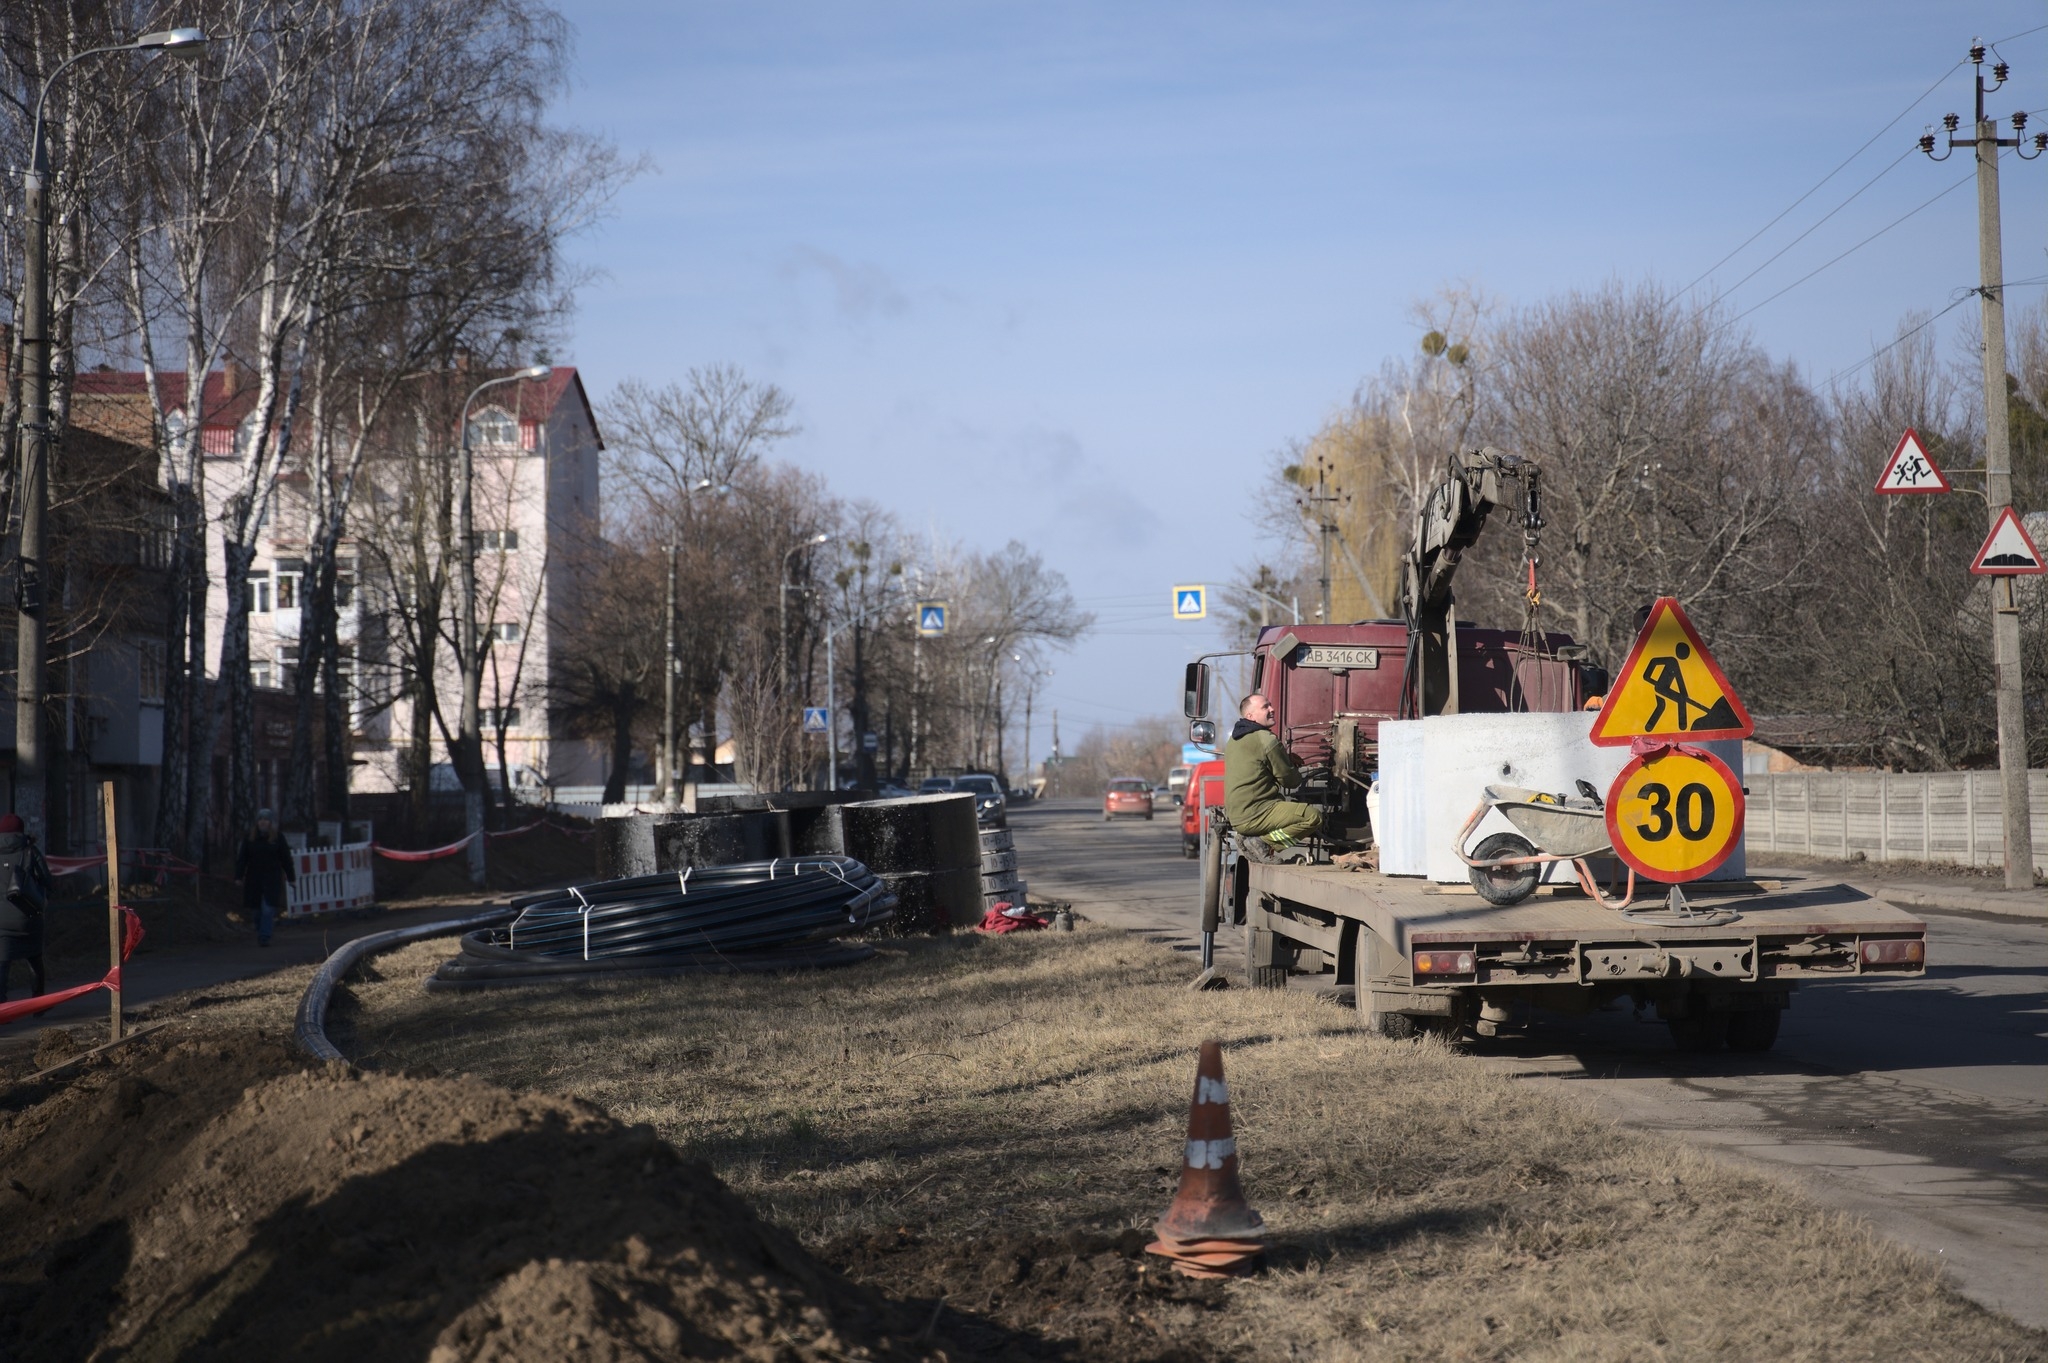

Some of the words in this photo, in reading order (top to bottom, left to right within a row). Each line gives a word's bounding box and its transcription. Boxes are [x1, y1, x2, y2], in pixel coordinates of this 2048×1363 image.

[1306, 650, 1323, 662] AB
[1326, 650, 1353, 663] 3416
[1355, 651, 1373, 663] CK
[1636, 782, 1715, 842] 30
